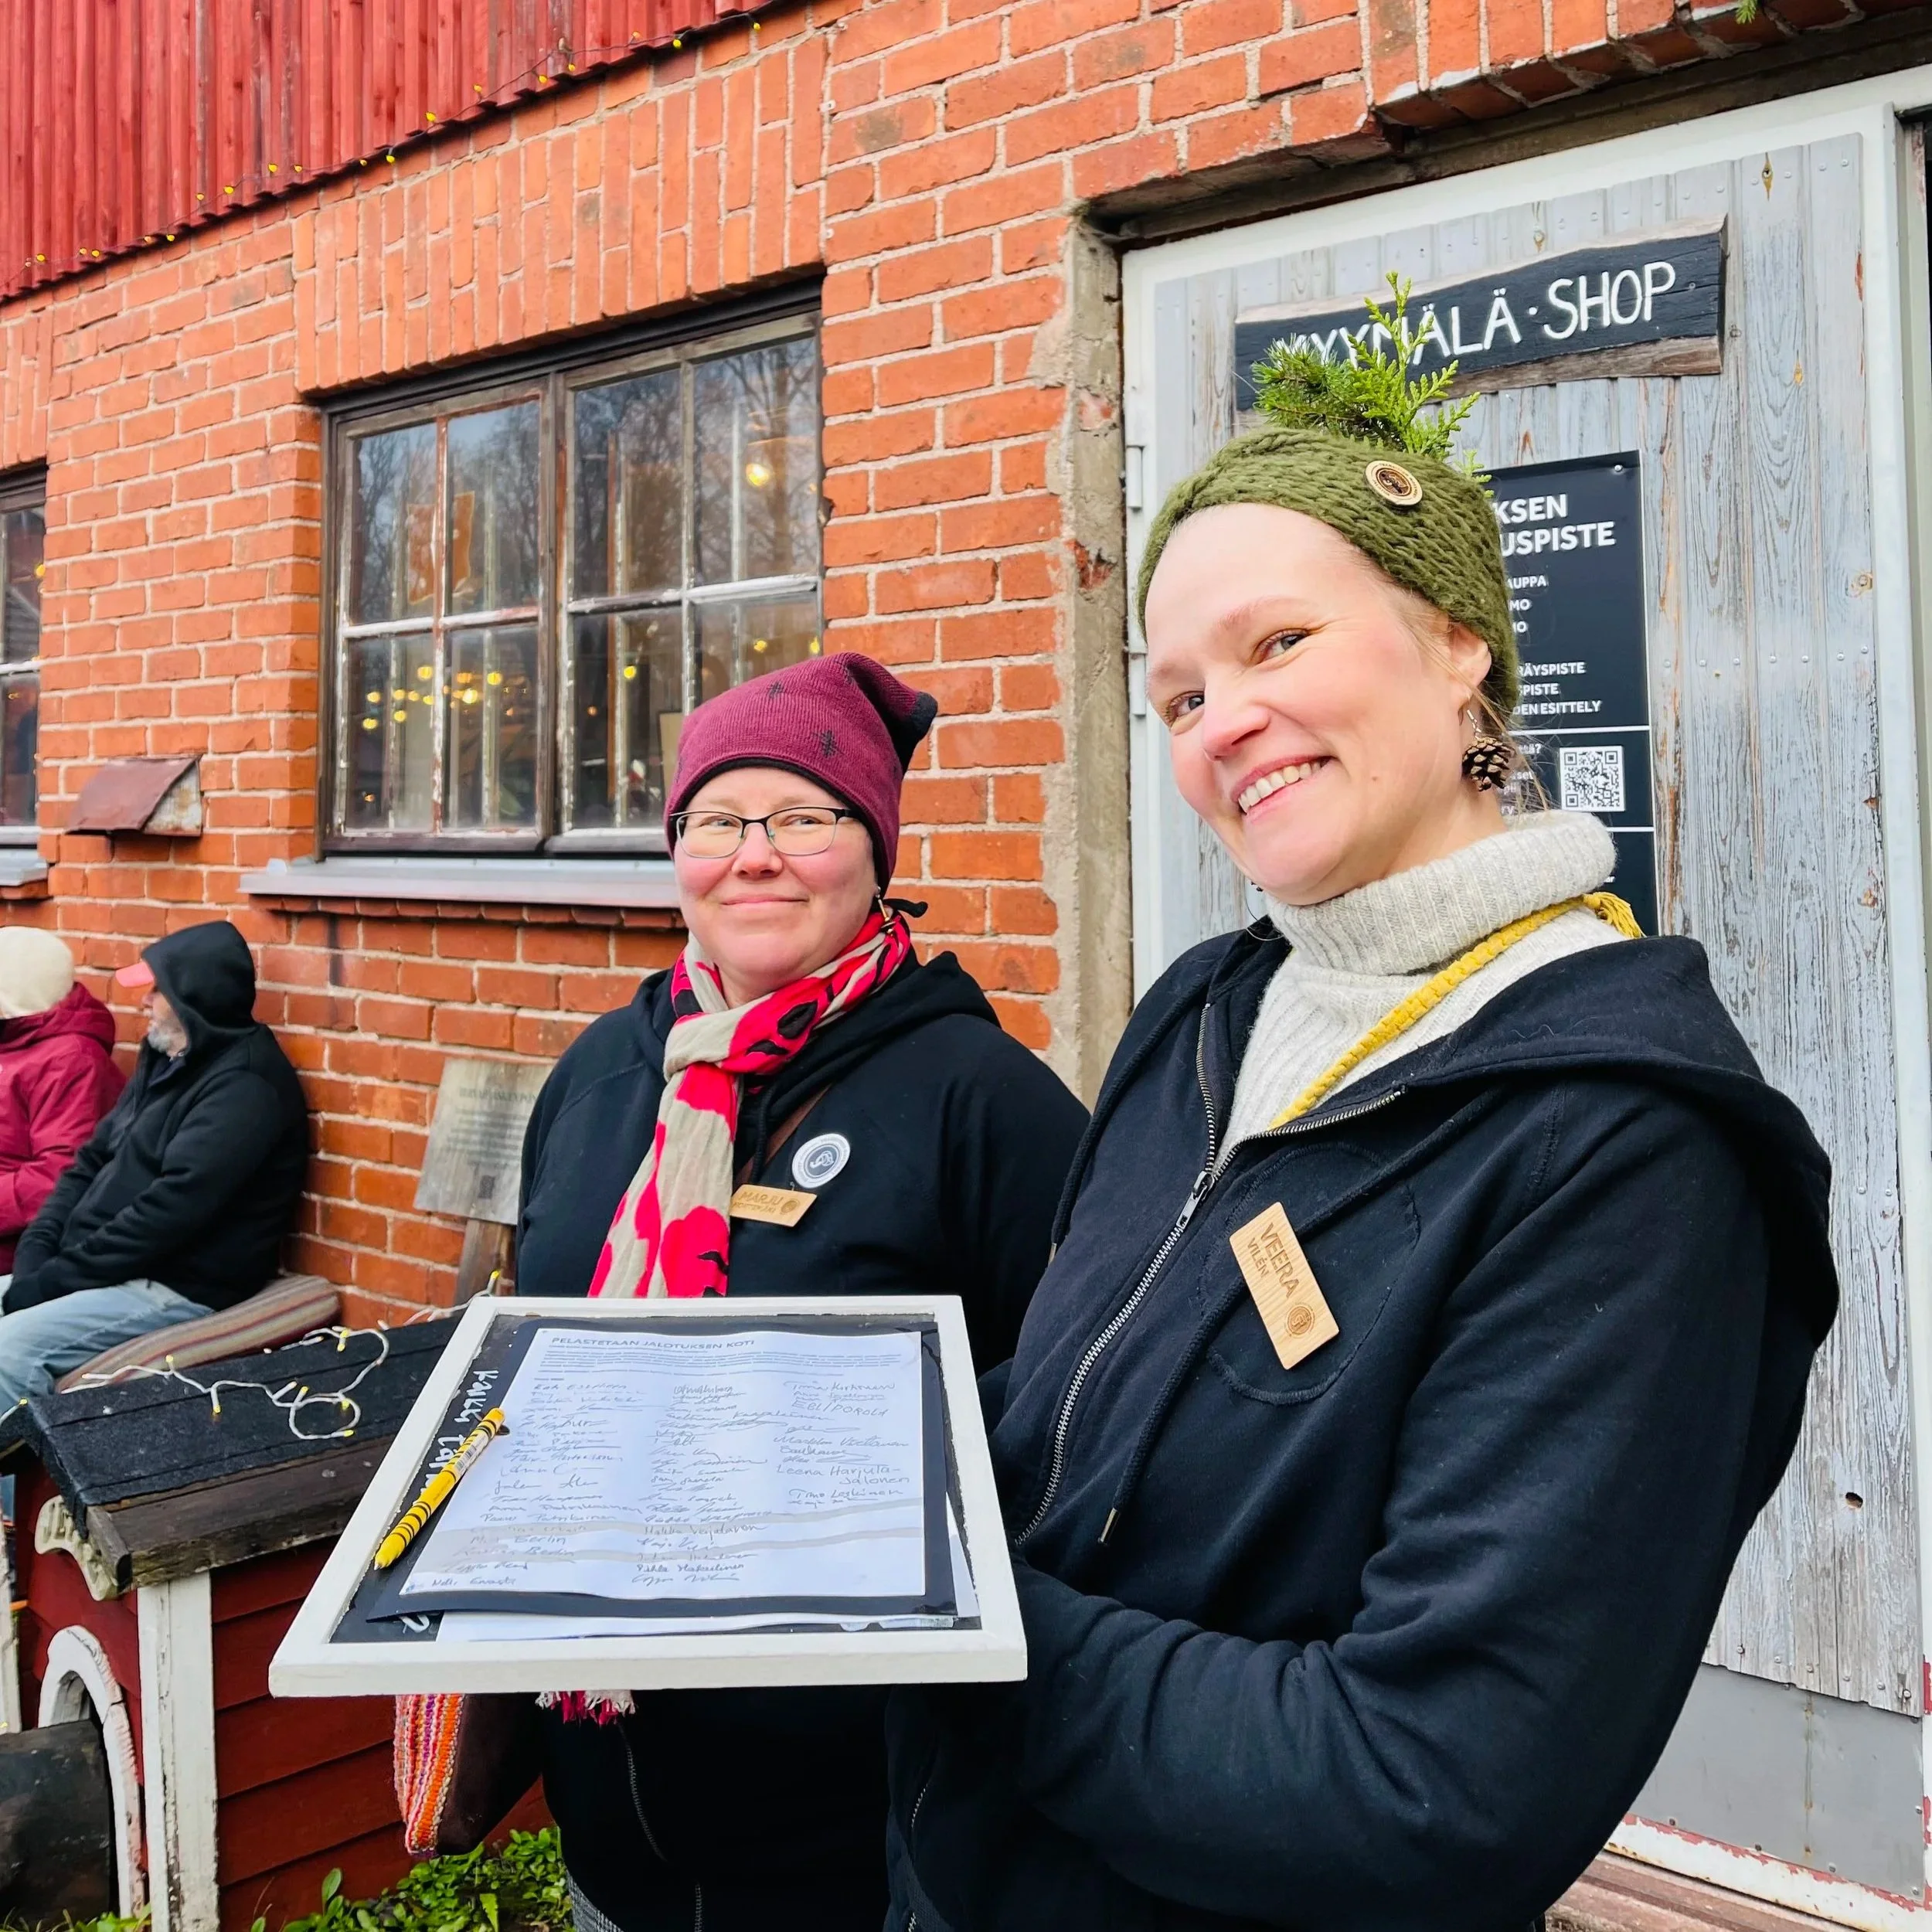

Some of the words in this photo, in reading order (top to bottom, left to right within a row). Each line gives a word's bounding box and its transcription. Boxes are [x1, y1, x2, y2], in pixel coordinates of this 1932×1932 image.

[1544, 261, 1676, 339] SHOP
[1500, 521, 1616, 557] USPISTE
[1540, 700, 1602, 715] ESITTELY
[1260, 1222, 1300, 1299] VEERA
[551, 1337, 640, 1347] PELASTETAAN
[643, 1341, 723, 1350] JALOTUKSEN
[726, 1339, 756, 1349] KOTI
